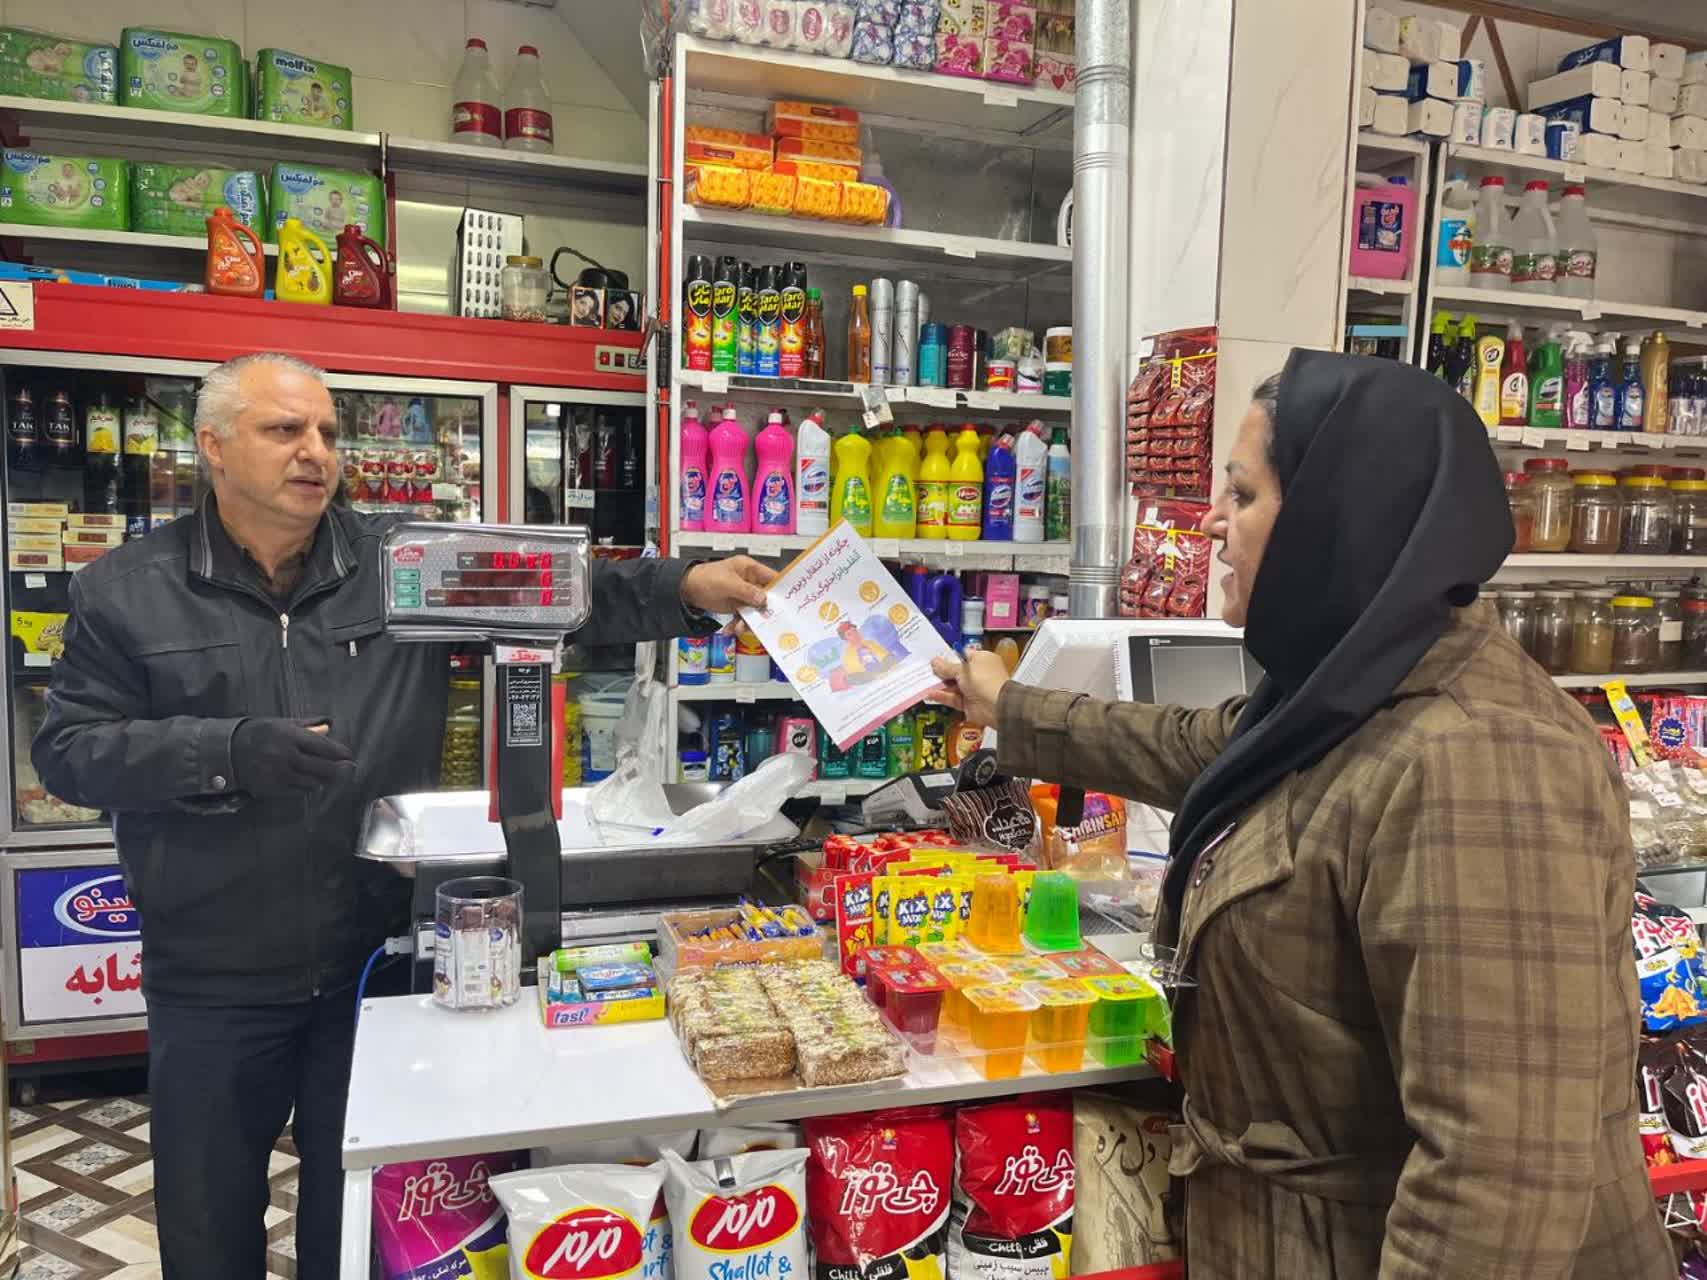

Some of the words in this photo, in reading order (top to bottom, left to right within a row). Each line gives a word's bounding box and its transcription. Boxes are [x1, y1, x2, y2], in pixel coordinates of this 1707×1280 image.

[275, 56, 316, 74] molfix
[829, 538, 849, 557] چگونه
[785, 577, 807, 599] ویروس
[16, 616, 24, 625] 5
[705, 1188, 776, 1245] مزمز
[541, 1214, 623, 1276] مزمز
[709, 1251, 774, 1280] Shallot
[778, 1255, 793, 1272] &
[829, 1268, 860, 1280] Chili
